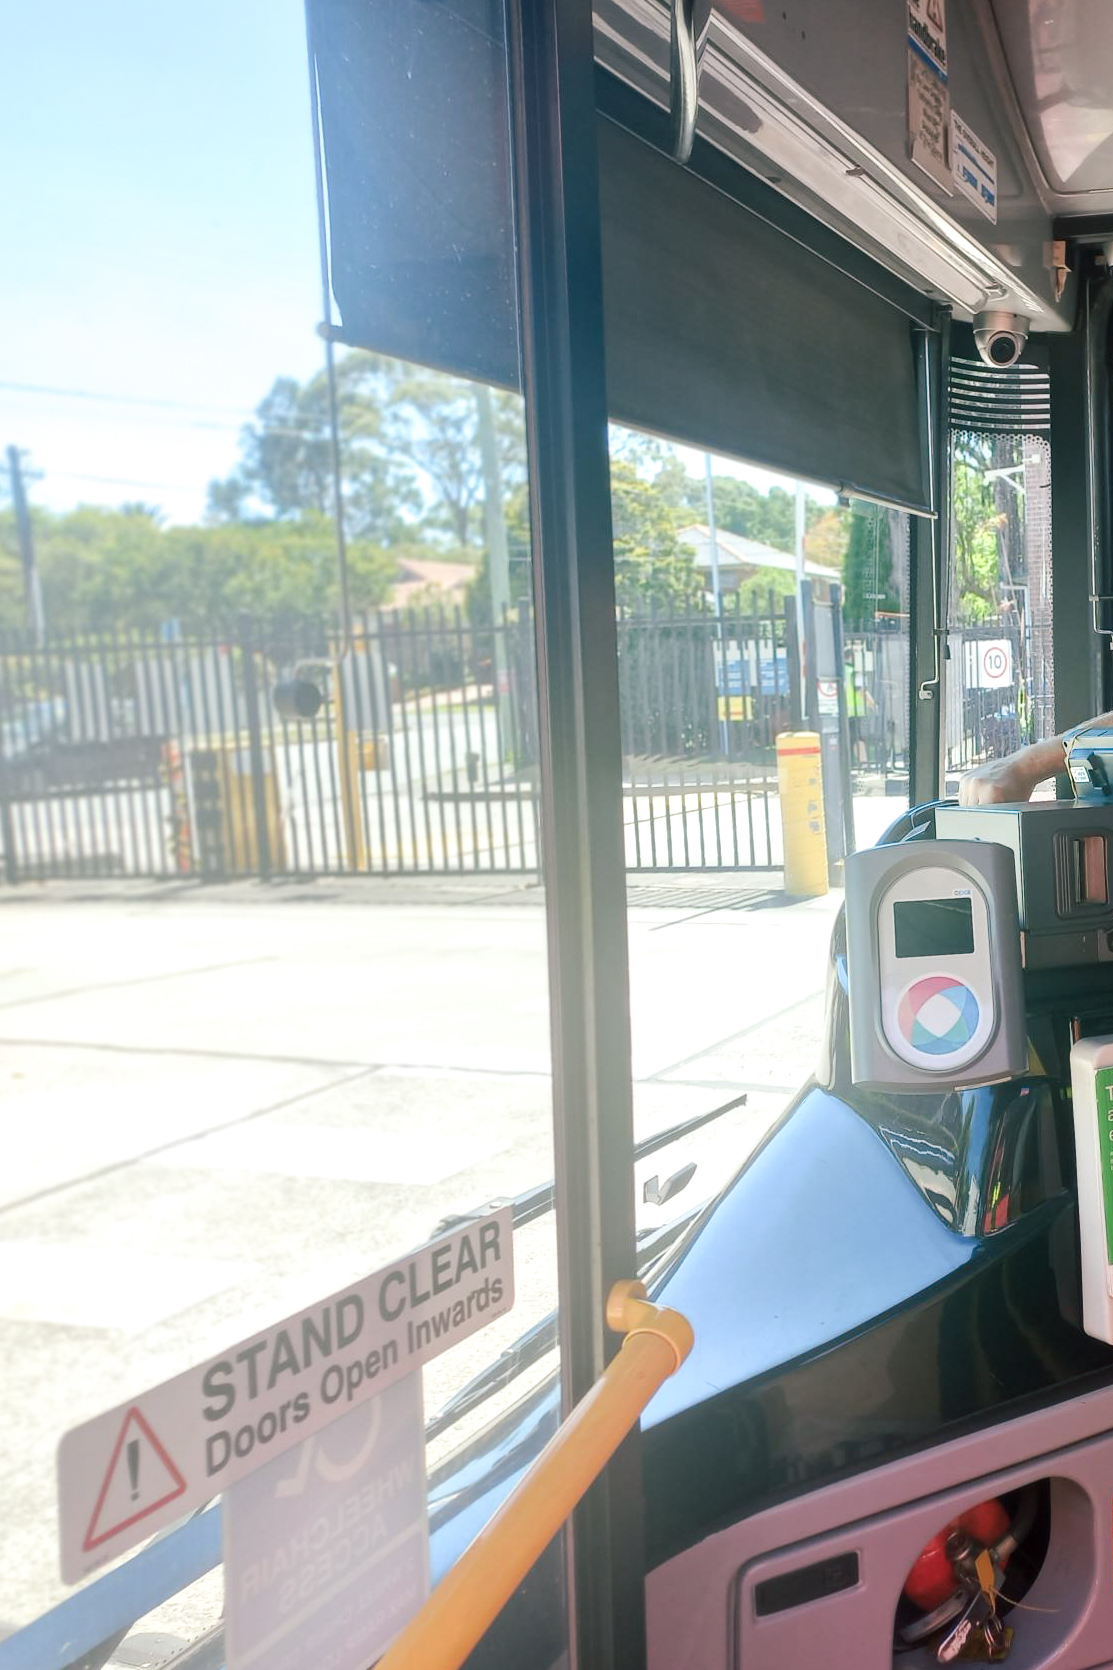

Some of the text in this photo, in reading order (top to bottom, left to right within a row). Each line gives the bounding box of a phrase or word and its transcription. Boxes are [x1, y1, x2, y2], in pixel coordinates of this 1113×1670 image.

[988, 654, 1002, 670] 10
[203, 1220, 502, 1422] STAND CLEAR
[205, 1277, 504, 1478] Doors Open Inwards
